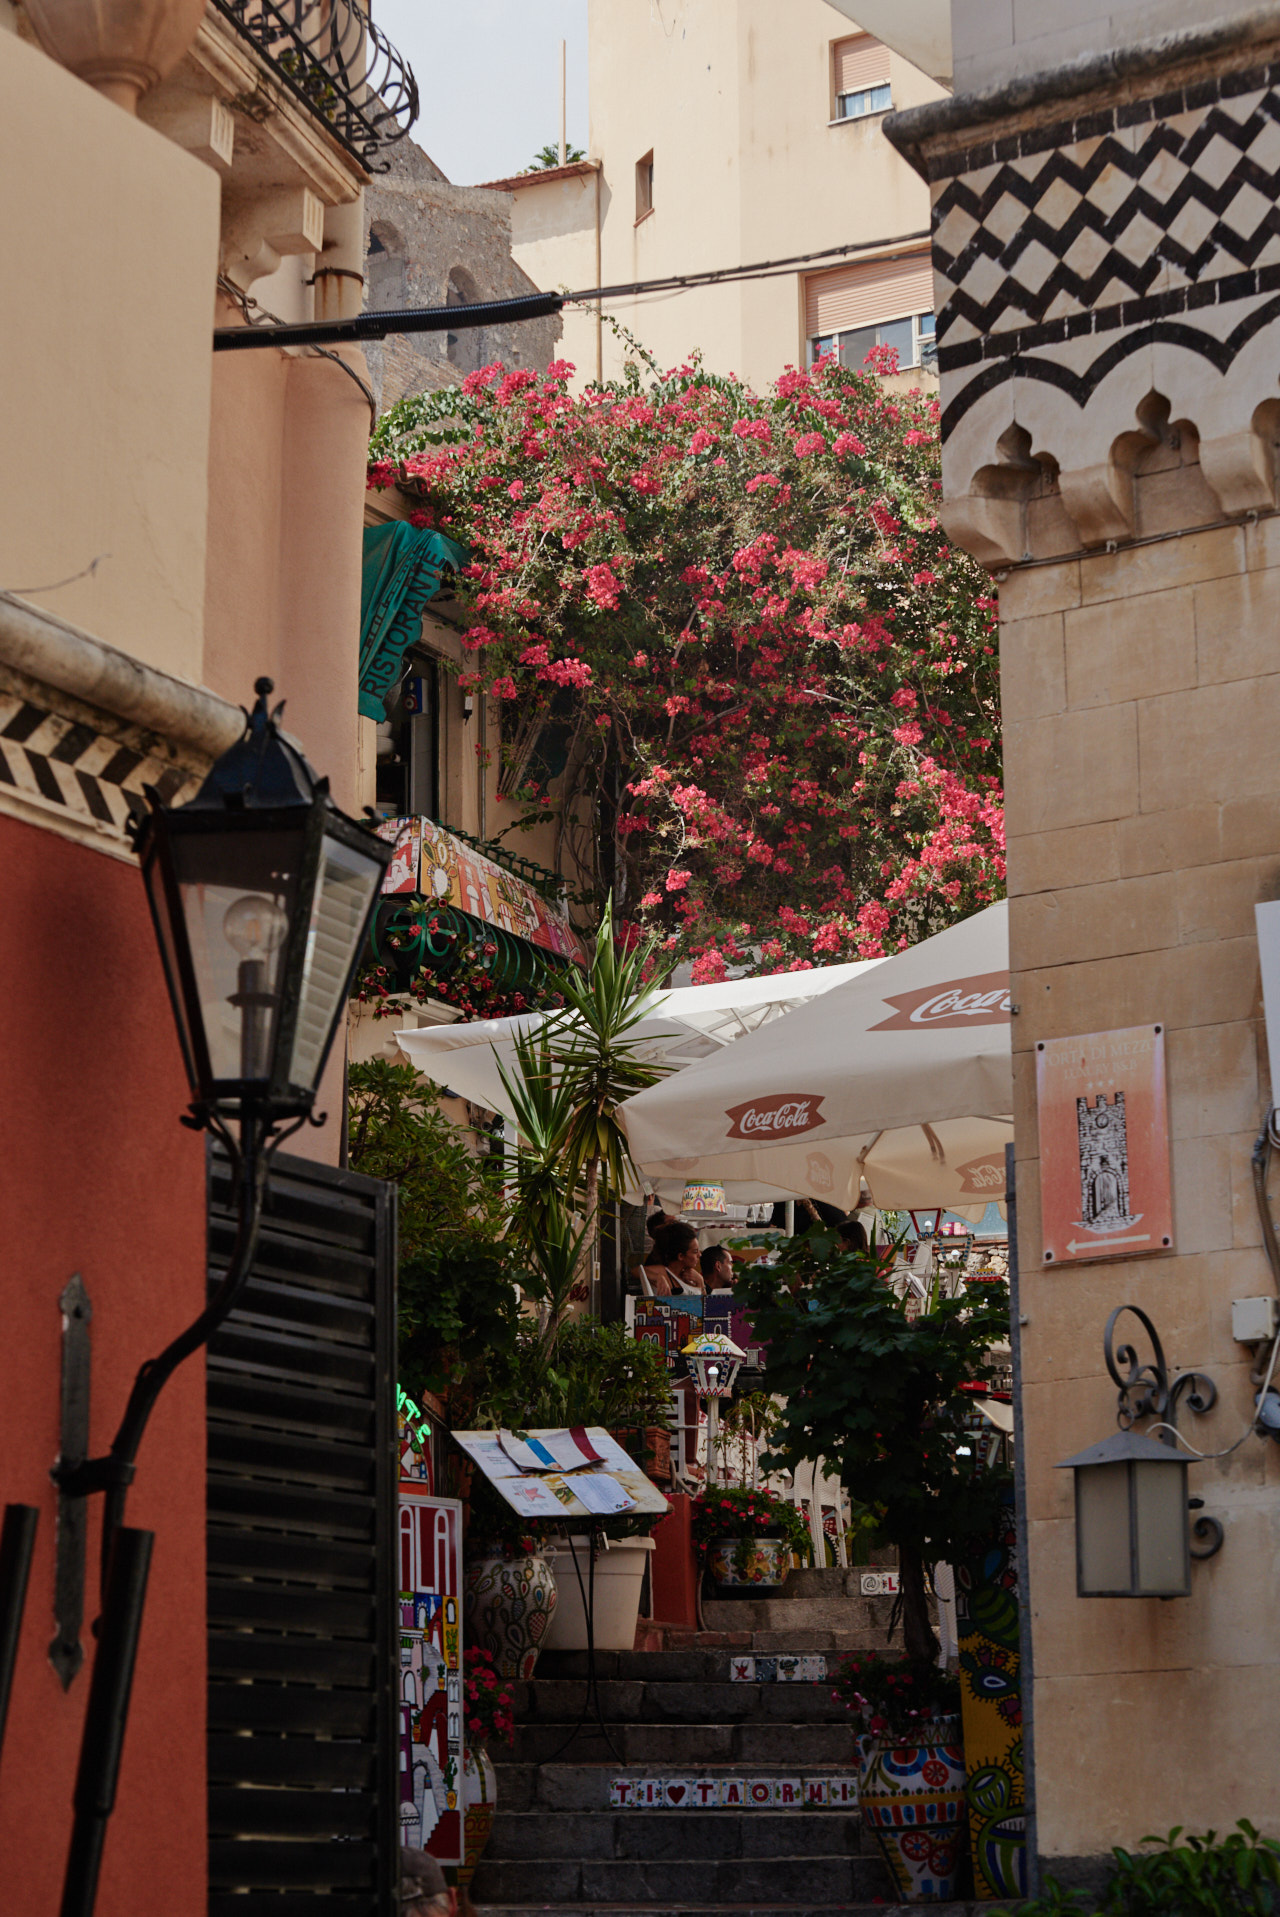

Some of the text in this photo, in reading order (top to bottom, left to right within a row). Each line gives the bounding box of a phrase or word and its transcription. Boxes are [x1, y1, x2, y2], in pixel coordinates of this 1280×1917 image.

[361, 549, 445, 700] RISTORANTE
[1091, 1045, 1106, 1060] DI
[739, 1100, 811, 1134] Coca-Cola
[399, 1505, 450, 1596] ALA
[616, 1783, 848, 1803] TI TAORMI
